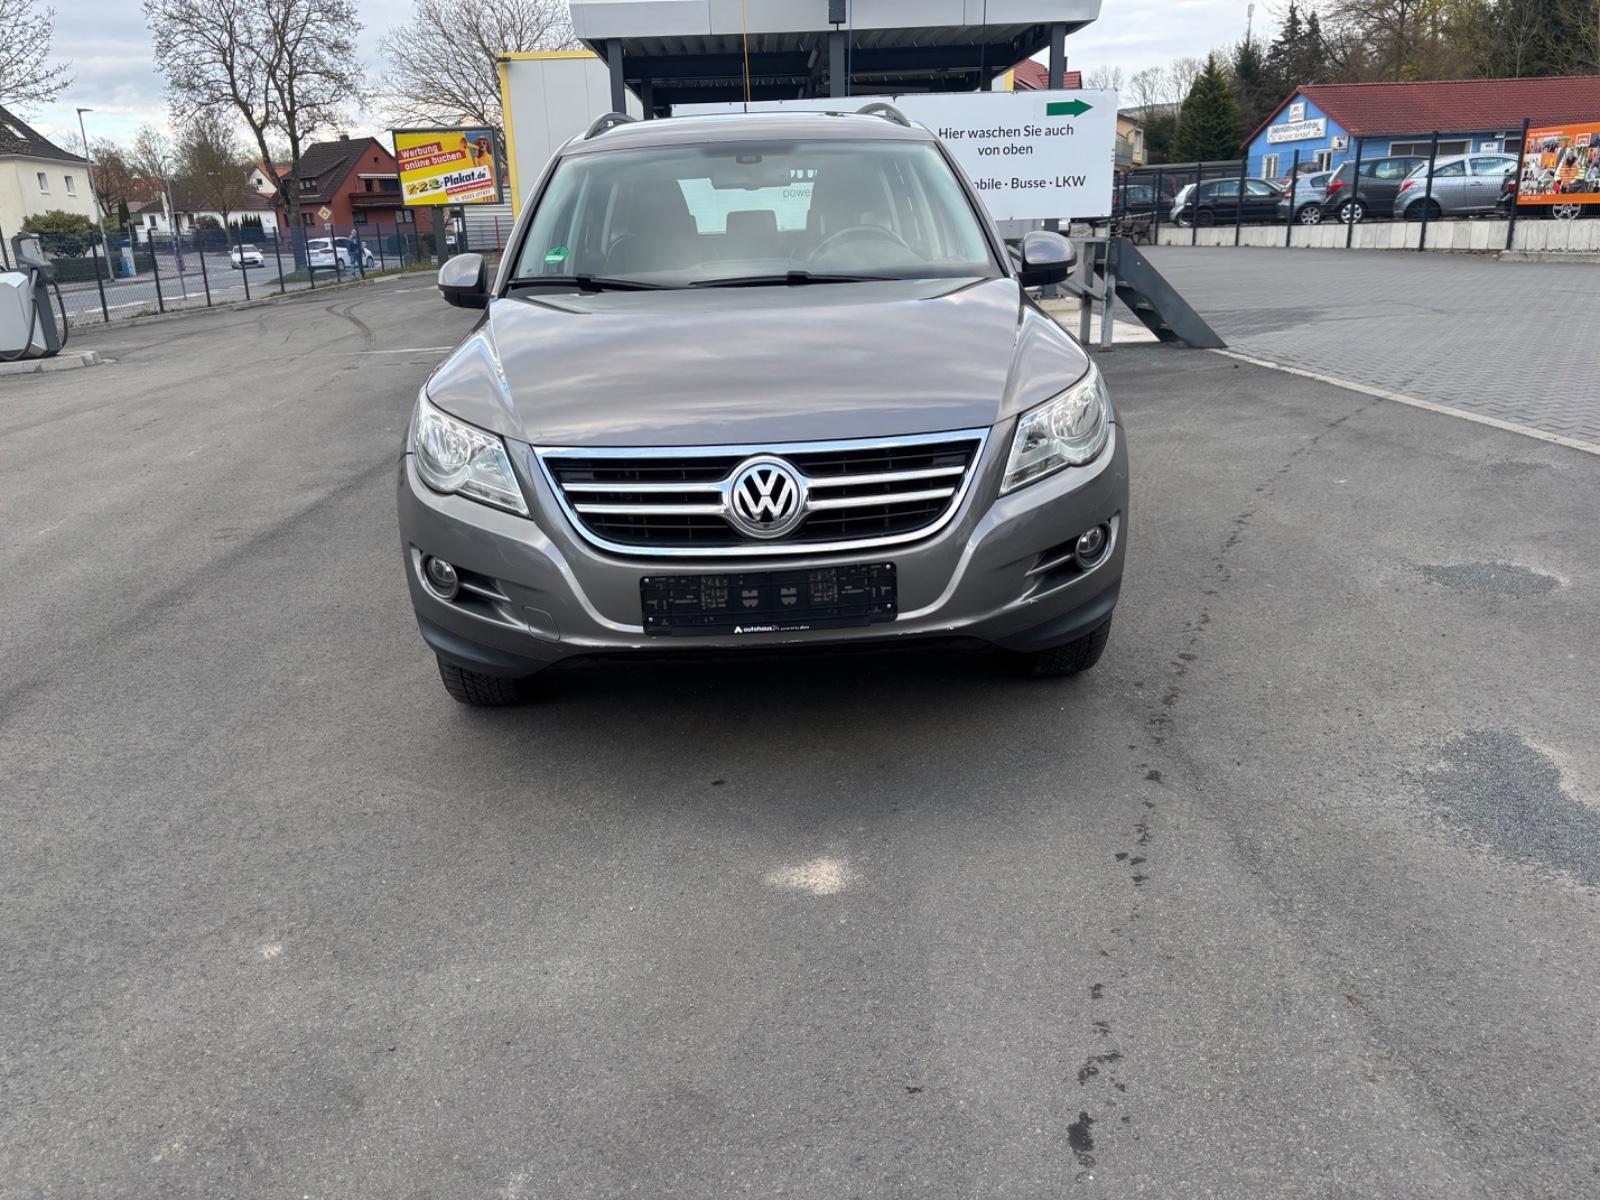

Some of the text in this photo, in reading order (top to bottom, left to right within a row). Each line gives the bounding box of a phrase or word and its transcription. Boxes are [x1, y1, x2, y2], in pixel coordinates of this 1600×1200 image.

[938, 123, 1074, 139] Hier waschen Sie auch
[401, 145, 438, 159] Werbung
[977, 143, 1033, 156] von oben
[404, 151, 462, 170] online buchen
[1011, 177, 1047, 189] Busse
[1055, 175, 1087, 188] LKW
[735, 464, 797, 526] VW
